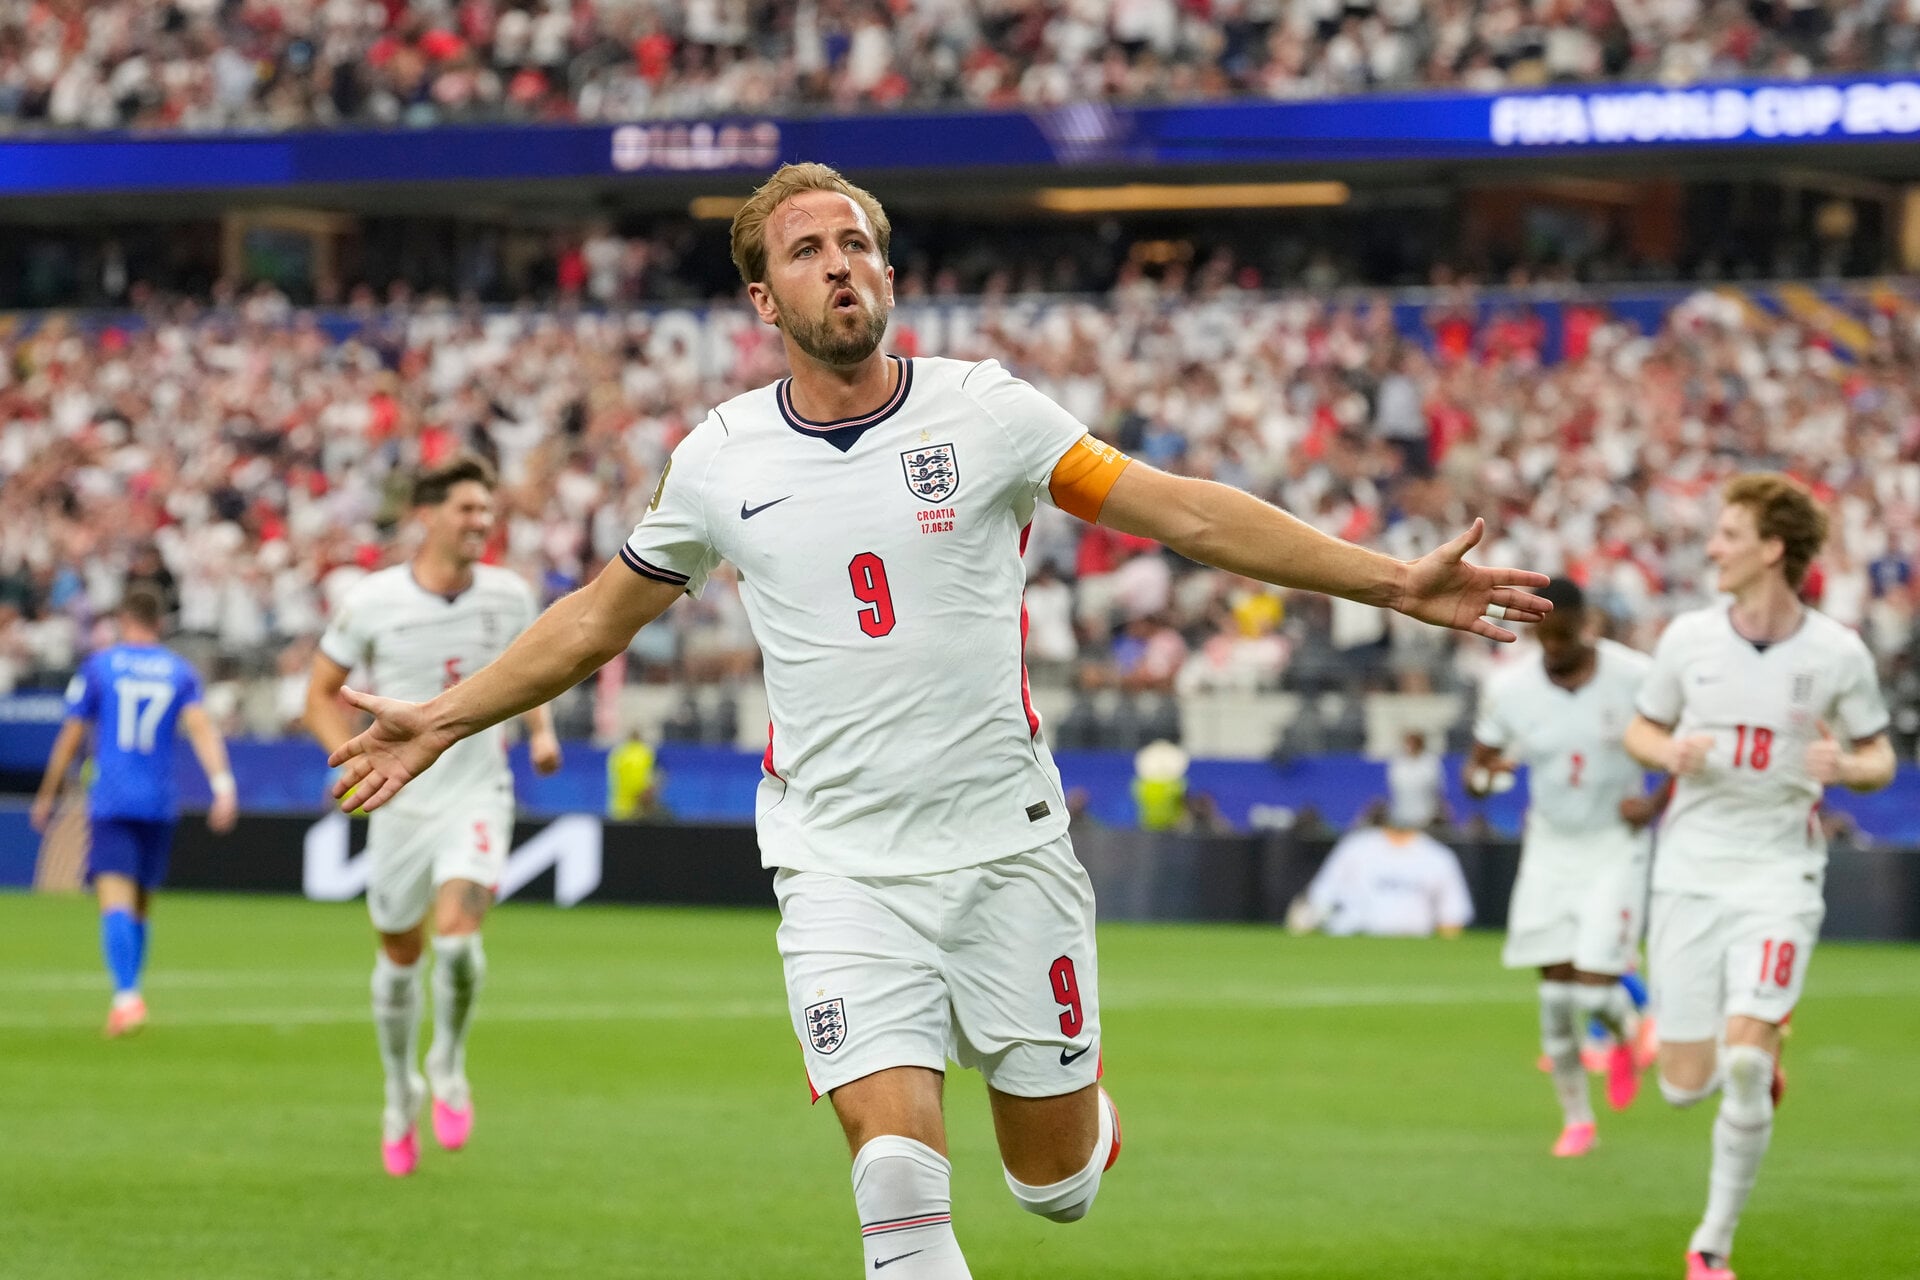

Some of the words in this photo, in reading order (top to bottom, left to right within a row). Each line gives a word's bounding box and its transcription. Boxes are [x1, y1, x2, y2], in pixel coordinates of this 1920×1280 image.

[1491, 96, 1587, 144] FIFA
[1589, 91, 1748, 141] WORLD
[1752, 87, 1843, 138] CUP
[917, 508, 956, 521] CROATIA
[921, 521, 954, 534] 17.06.26
[848, 552, 896, 638] 9
[444, 656, 461, 688] 5
[116, 678, 174, 753] 17
[1733, 724, 1774, 771] 18
[1761, 938, 1796, 988] 18
[1049, 955, 1083, 1038] 9
